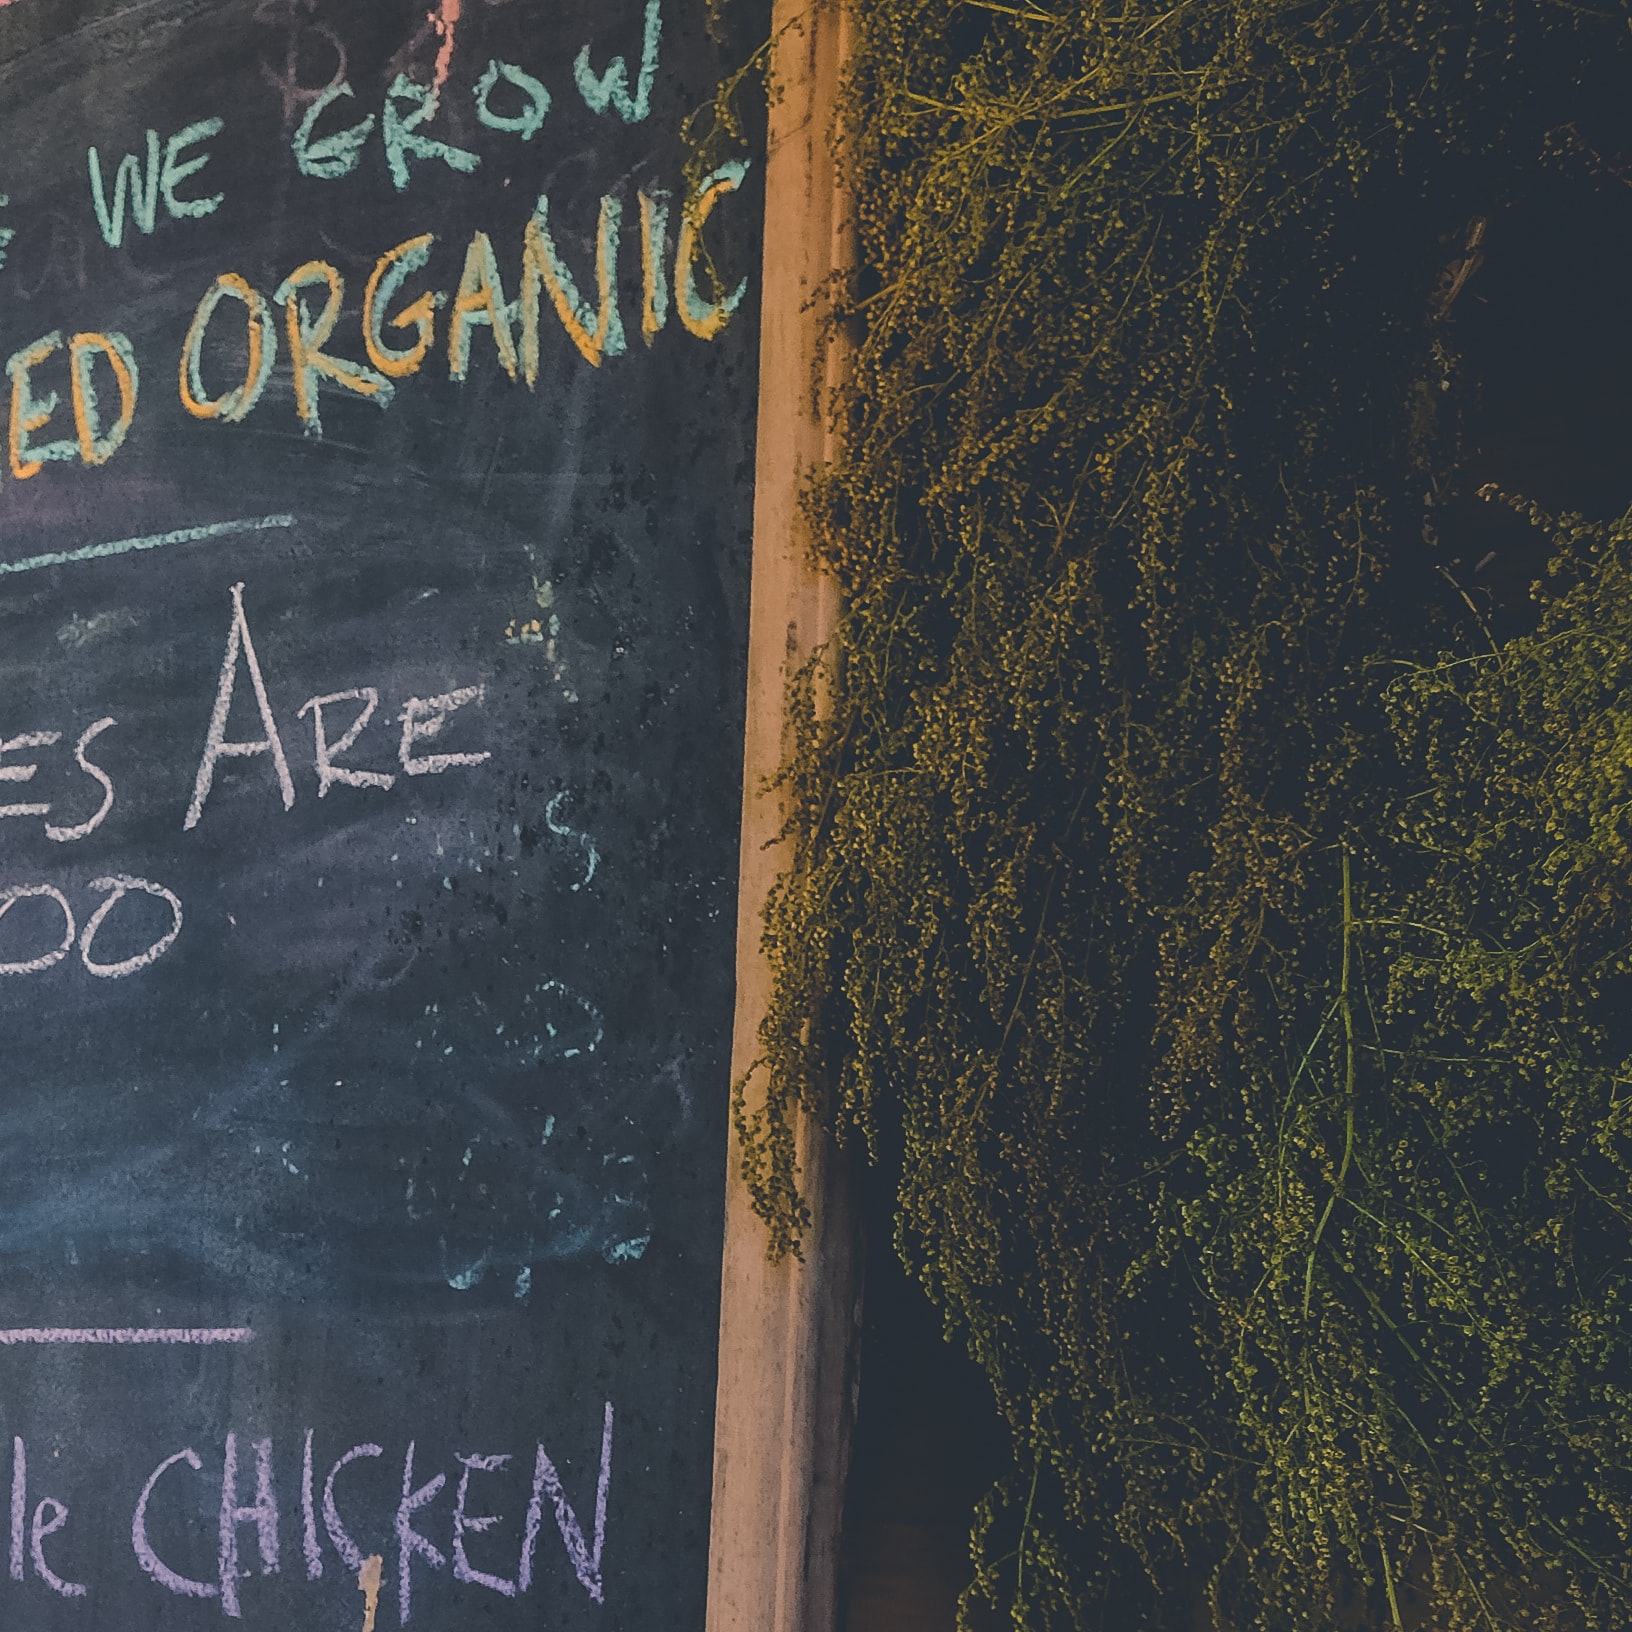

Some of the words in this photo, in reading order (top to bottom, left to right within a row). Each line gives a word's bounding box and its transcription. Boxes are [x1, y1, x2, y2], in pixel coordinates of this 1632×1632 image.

[87, 115, 225, 249] WE
[291, 0, 663, 192] GROW
[179, 157, 753, 438] ORGANIC
[182, 580, 492, 832] ARE
[132, 1400, 615, 1628] CHICKEN
